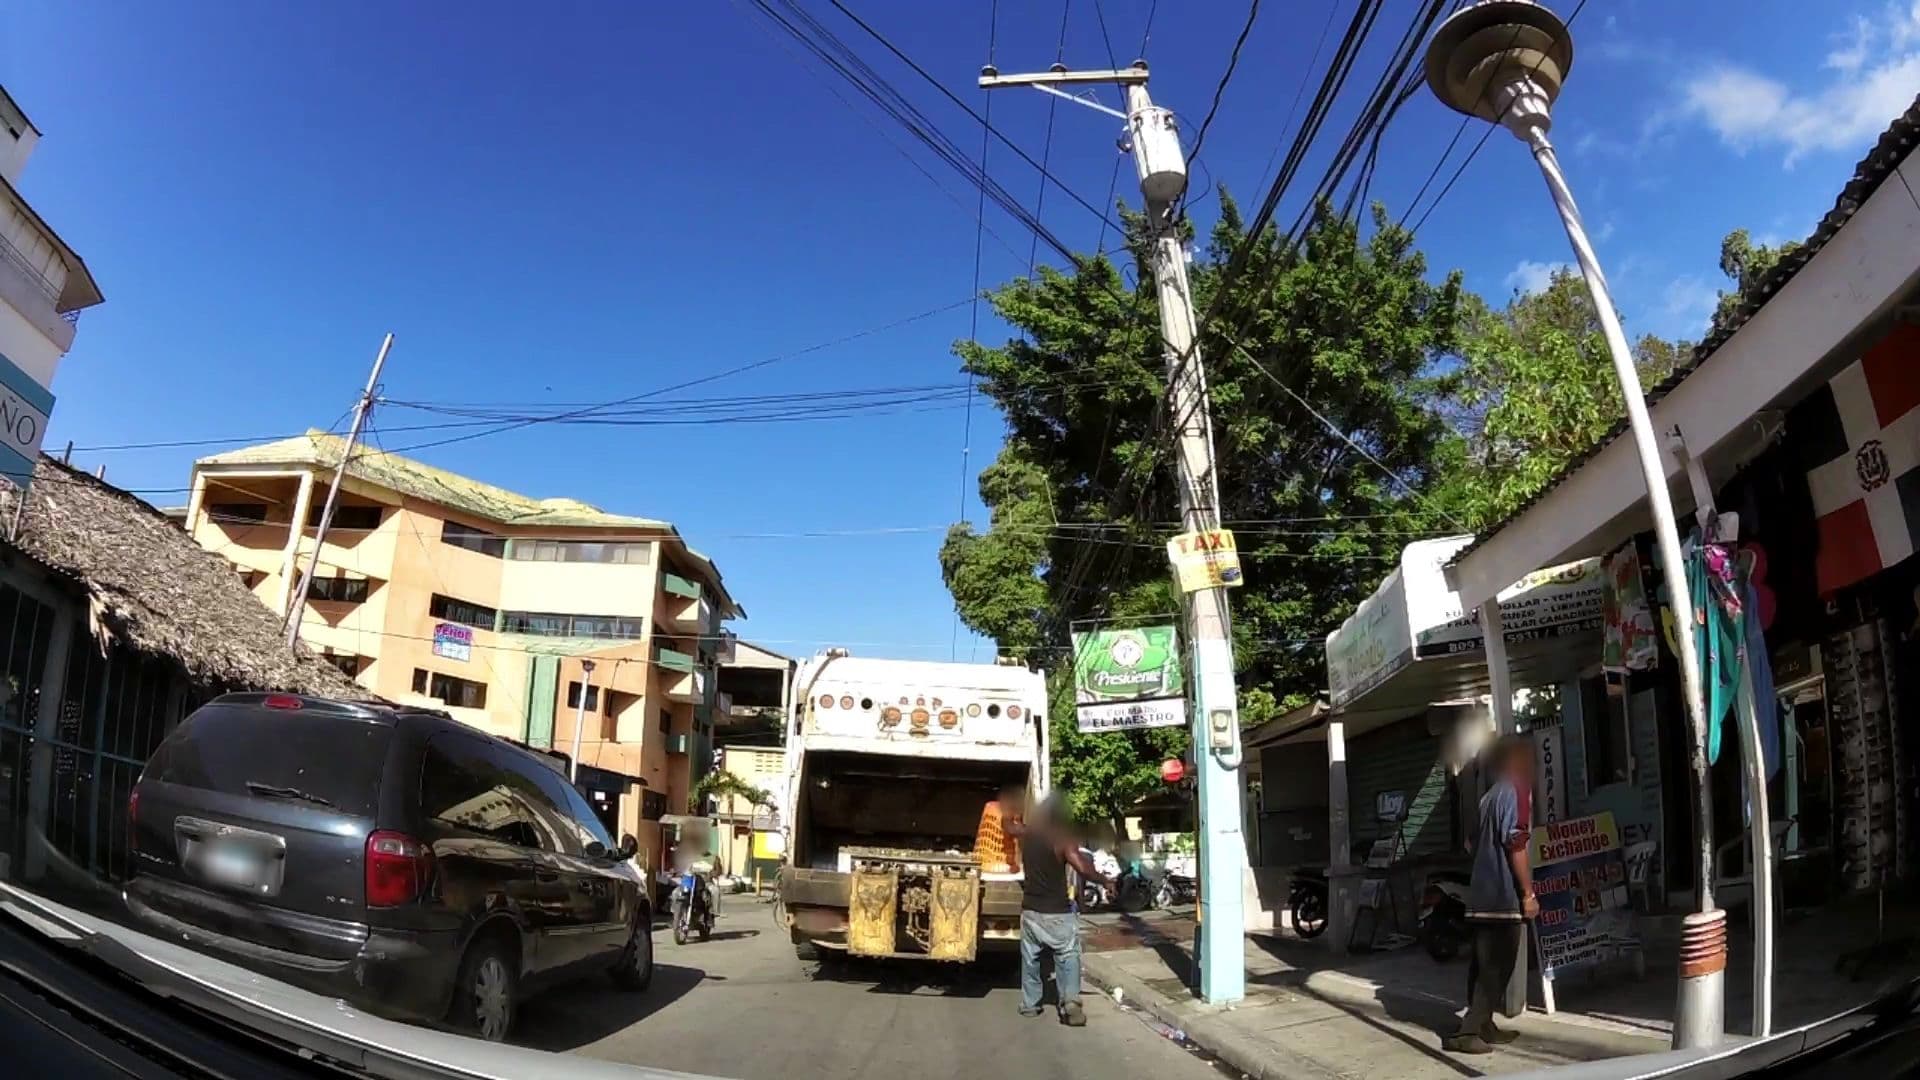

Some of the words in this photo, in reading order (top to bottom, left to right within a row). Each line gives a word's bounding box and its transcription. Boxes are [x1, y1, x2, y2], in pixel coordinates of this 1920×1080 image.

[1175, 532, 1233, 554] TAXI
[1093, 717, 1109, 729] EL
[1113, 711, 1175, 727] MAESTRO
[1546, 818, 1596, 841] Money
[1618, 823, 1652, 846] EY
[1540, 834, 1610, 861] Exchange
[1541, 908, 1569, 925] Euro
